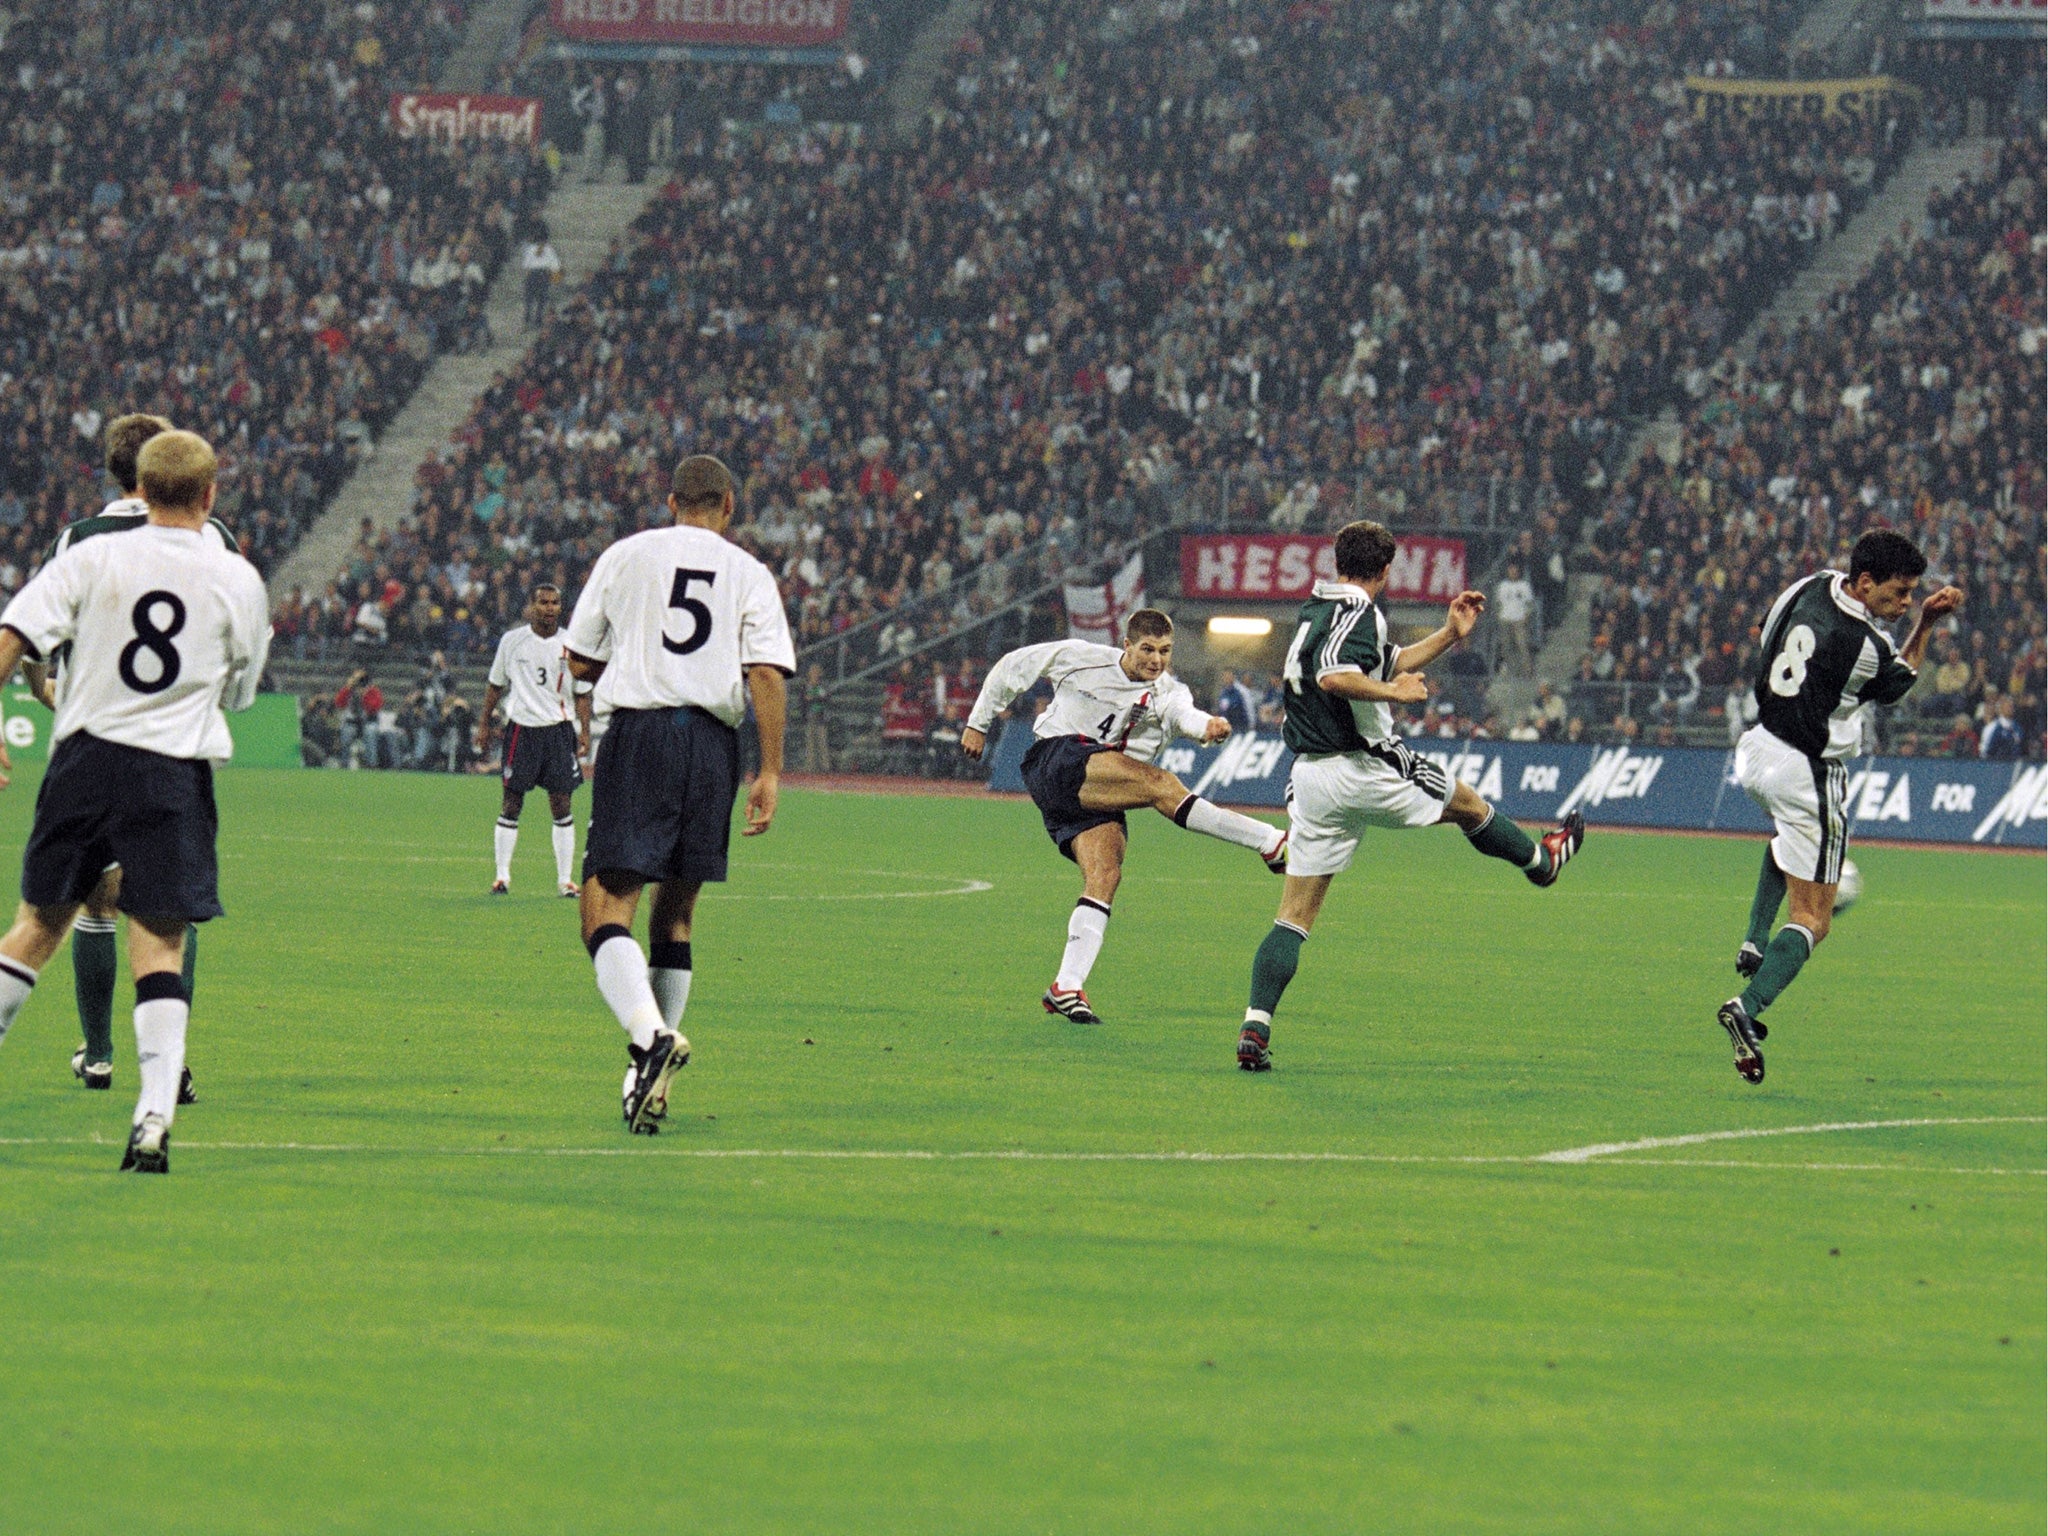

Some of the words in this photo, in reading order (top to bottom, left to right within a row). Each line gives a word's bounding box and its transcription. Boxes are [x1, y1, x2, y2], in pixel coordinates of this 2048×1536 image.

[561, 0, 638, 21] RED
[654, 0, 836, 26] RELIGION
[1197, 543, 1466, 595] HESSNN
[662, 568, 716, 656] 5
[119, 590, 187, 694] 8
[1770, 624, 1816, 697] 8
[537, 667, 547, 686] 3
[1097, 713, 1116, 740] 4
[1160, 748, 1196, 773] FOR
[1193, 731, 1288, 796] MEN
[1520, 765, 1559, 792] FOR
[1555, 746, 1663, 819] MEN
[1931, 783, 1976, 812] FOR
